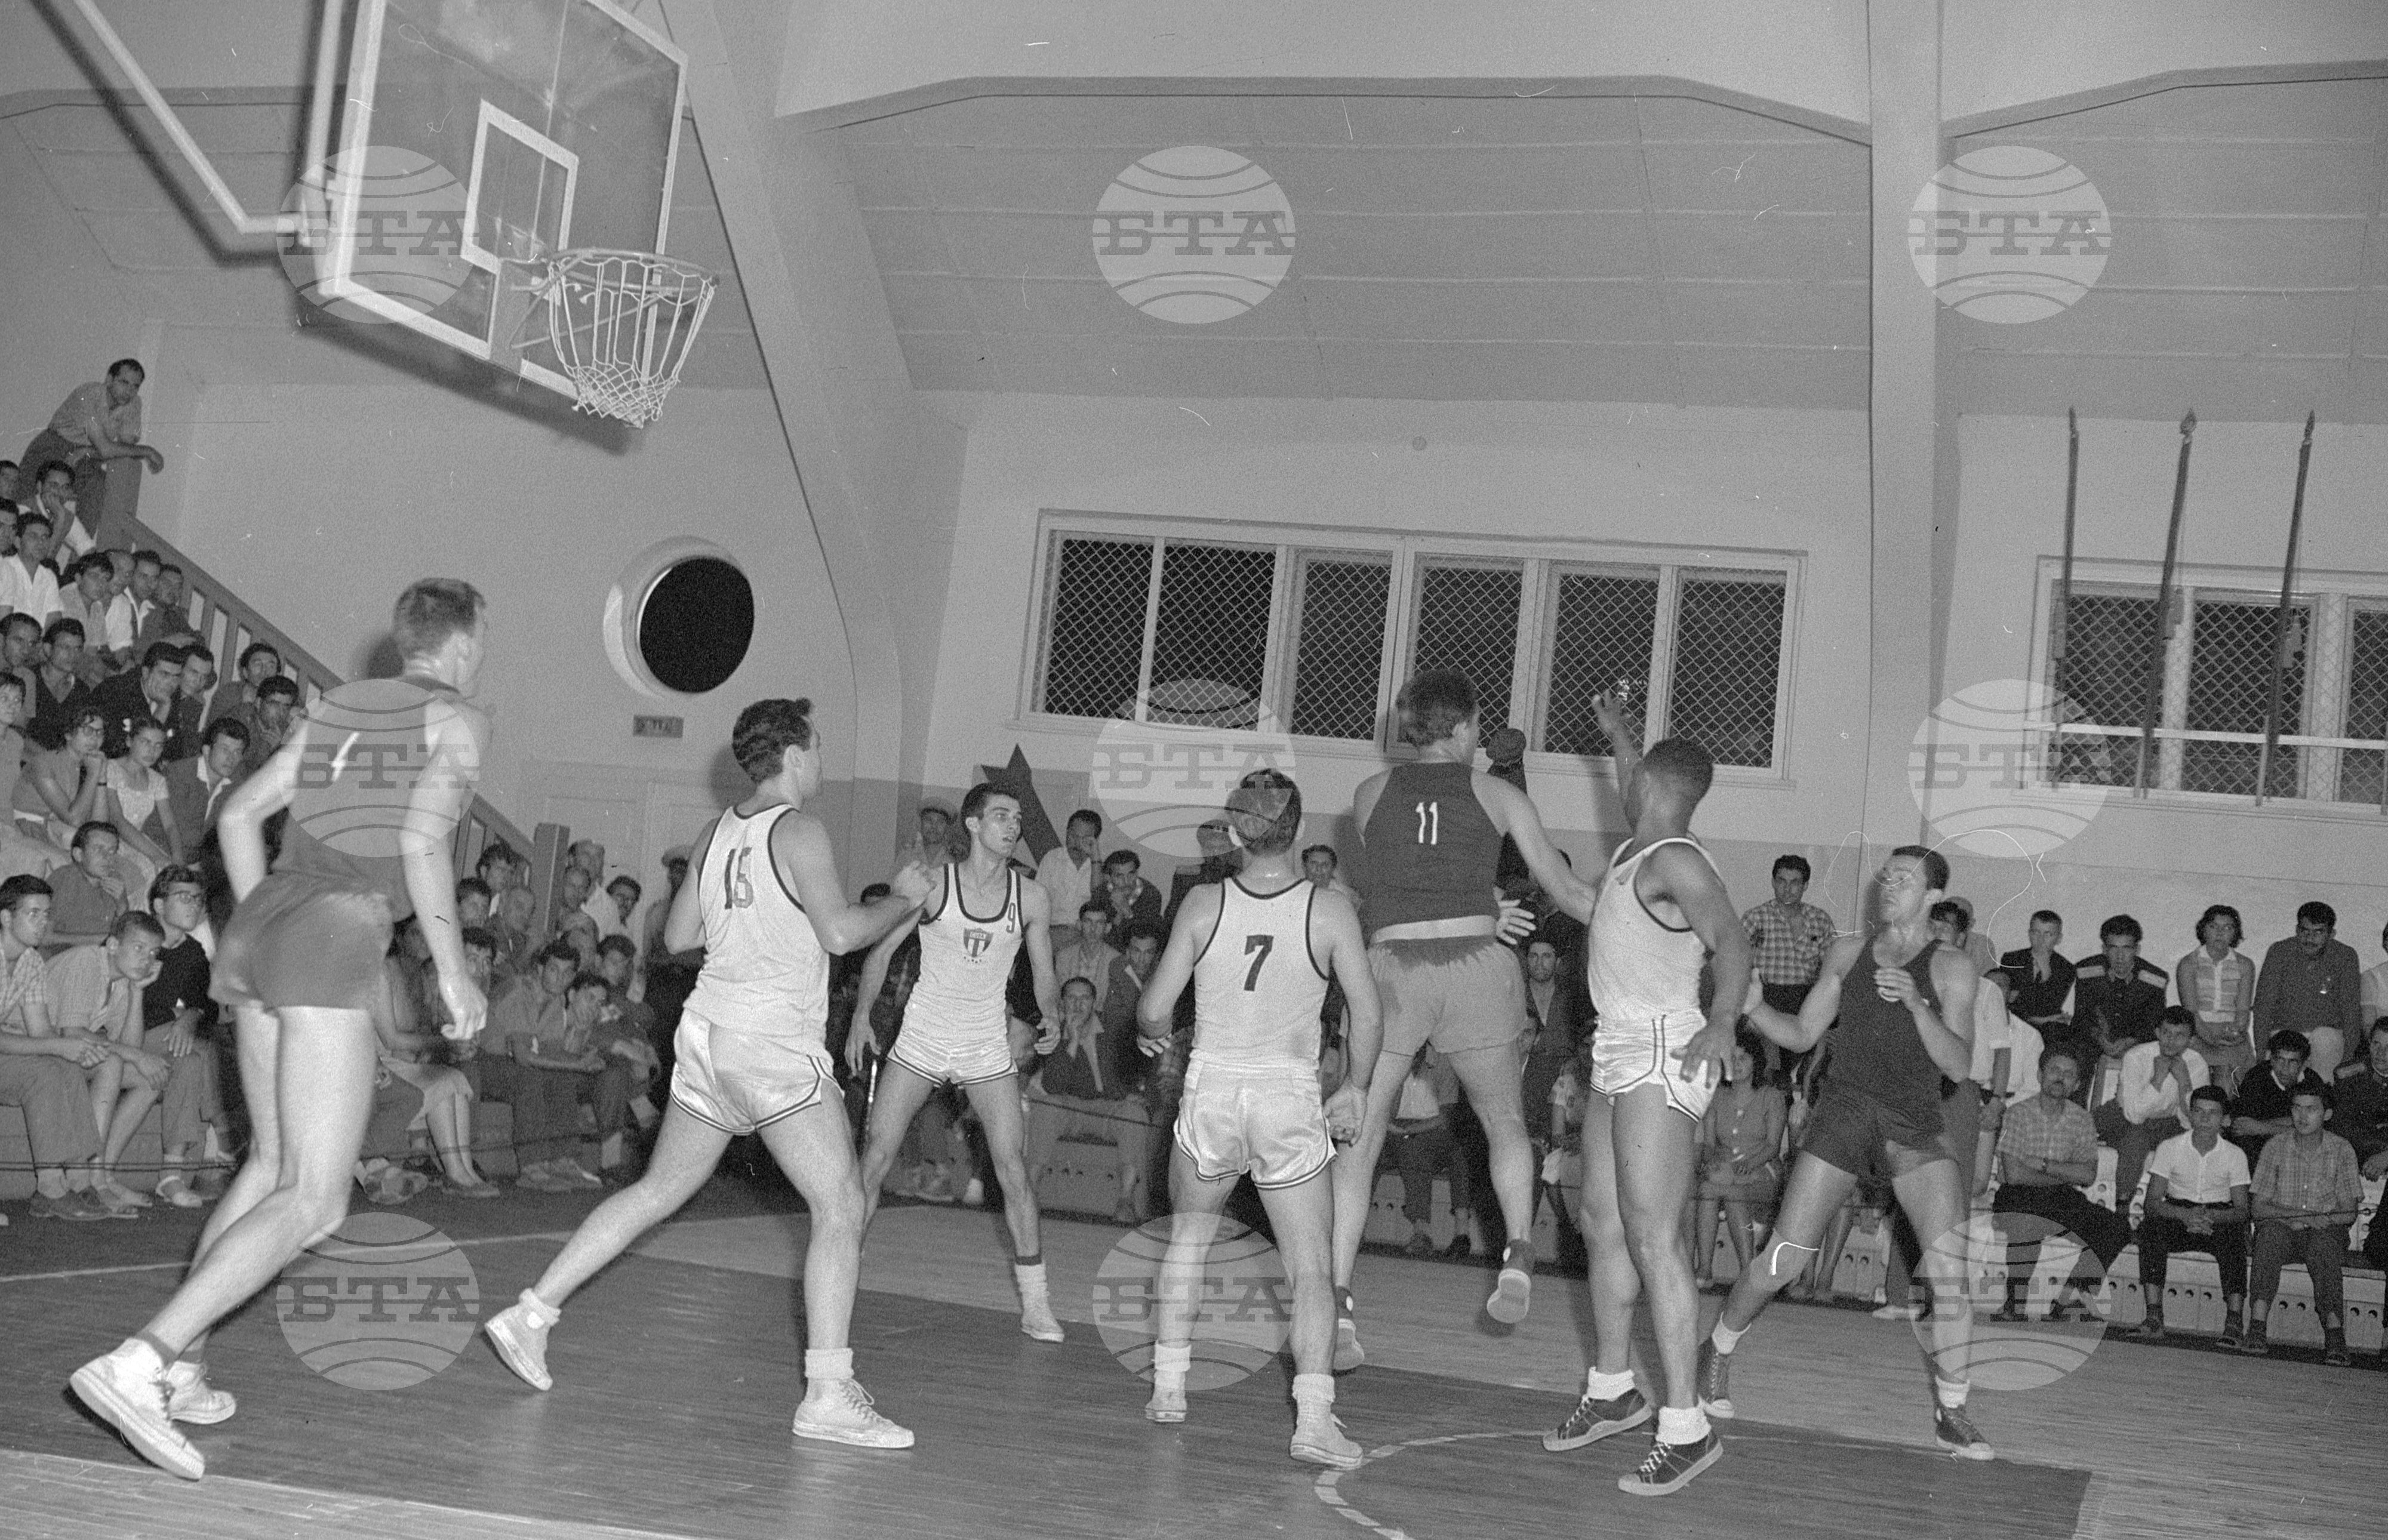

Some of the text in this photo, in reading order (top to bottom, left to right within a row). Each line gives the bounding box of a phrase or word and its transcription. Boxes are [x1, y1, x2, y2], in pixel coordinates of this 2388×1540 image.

[1415, 802, 1438, 845] 11
[724, 846, 753, 910] 16
[1006, 902, 1015, 934] 9
[1244, 934, 1274, 991] 7
